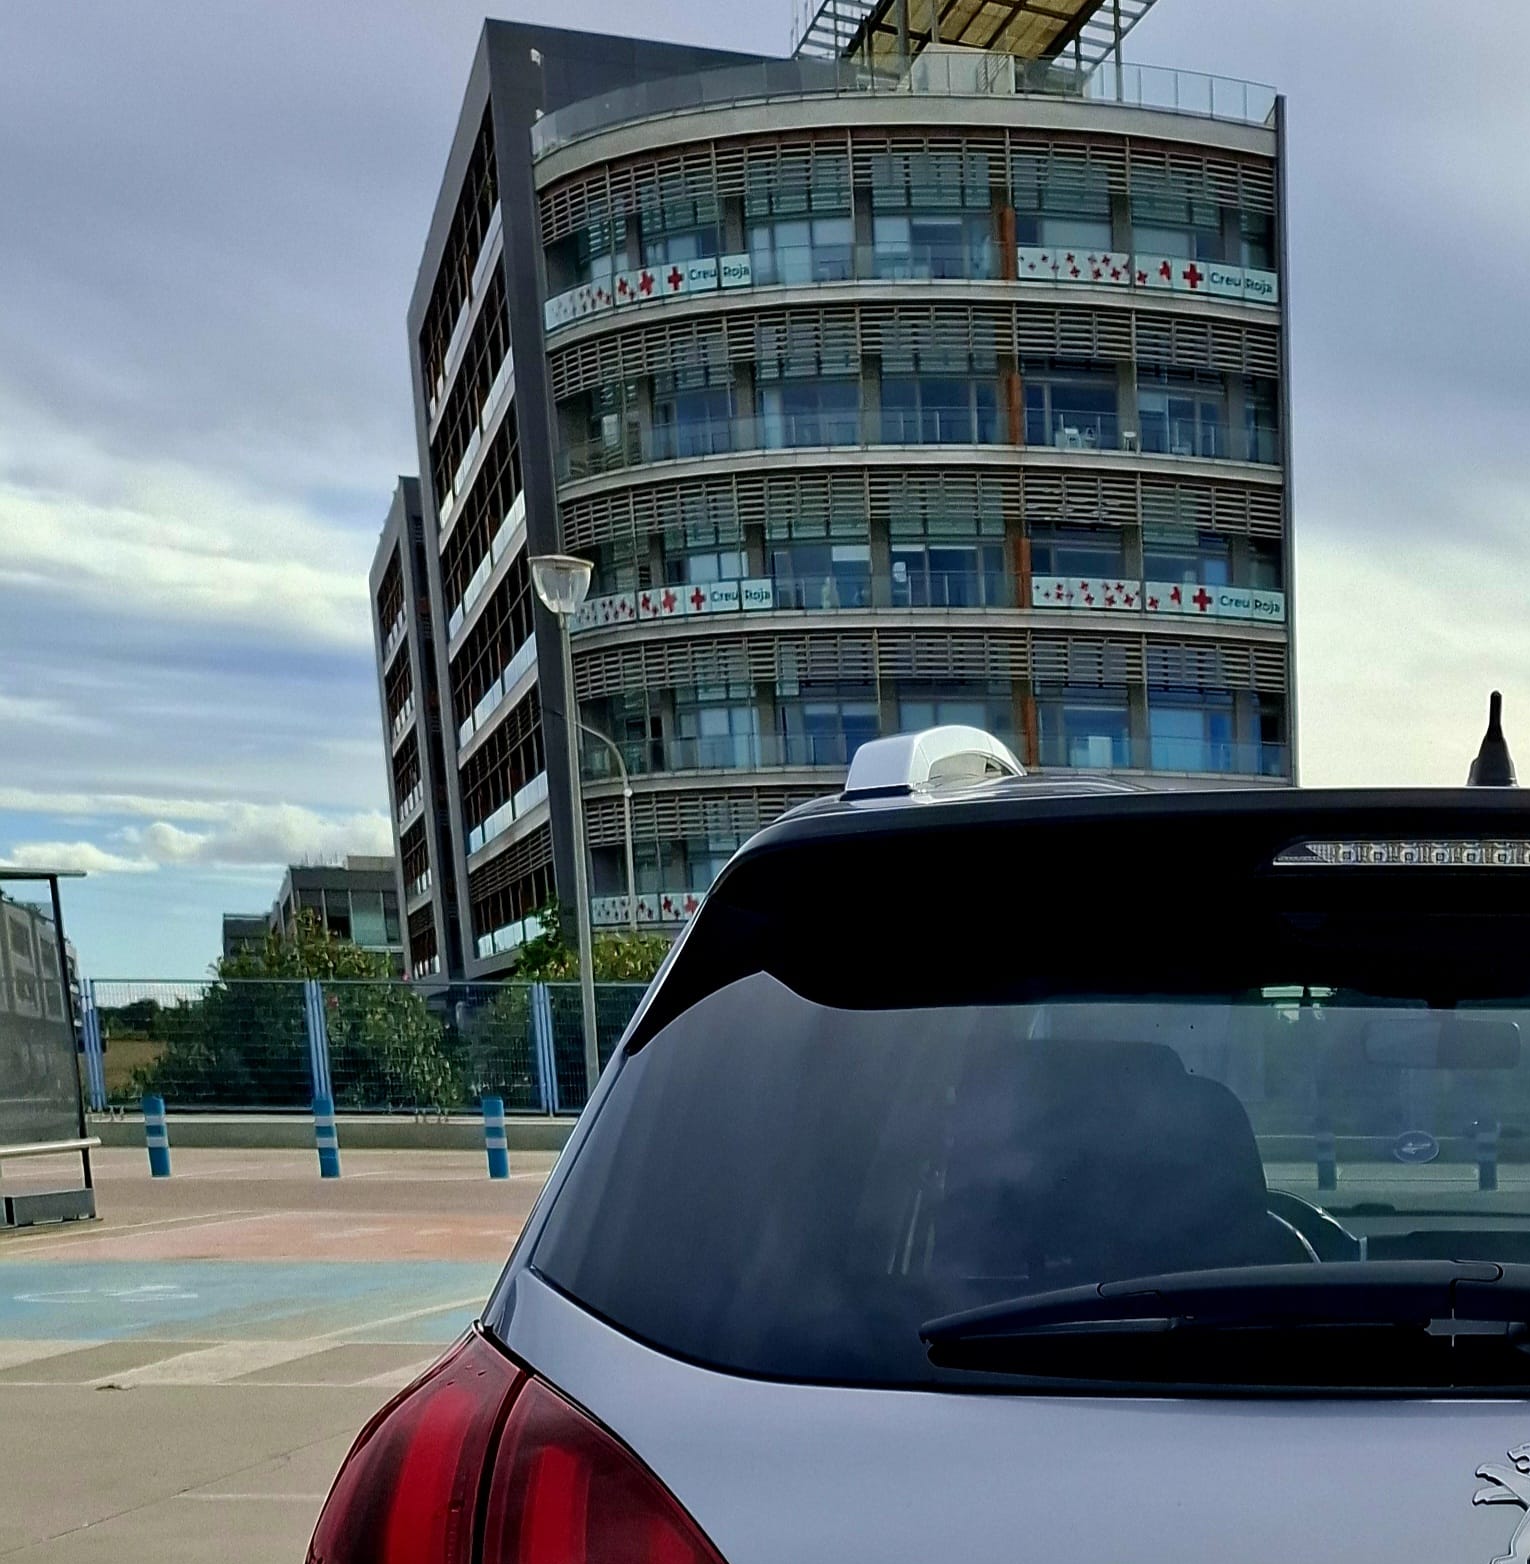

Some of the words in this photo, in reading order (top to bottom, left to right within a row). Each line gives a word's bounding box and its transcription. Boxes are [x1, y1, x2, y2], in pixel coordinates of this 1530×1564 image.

[689, 266, 717, 282] Creu
[723, 263, 750, 279] Roja
[1210, 271, 1242, 288] Creu
[1243, 275, 1273, 295] Roja
[711, 589, 738, 603] Creu
[744, 587, 771, 603] Roja
[1219, 594, 1250, 609] Creu
[1253, 598, 1281, 615] Roja
